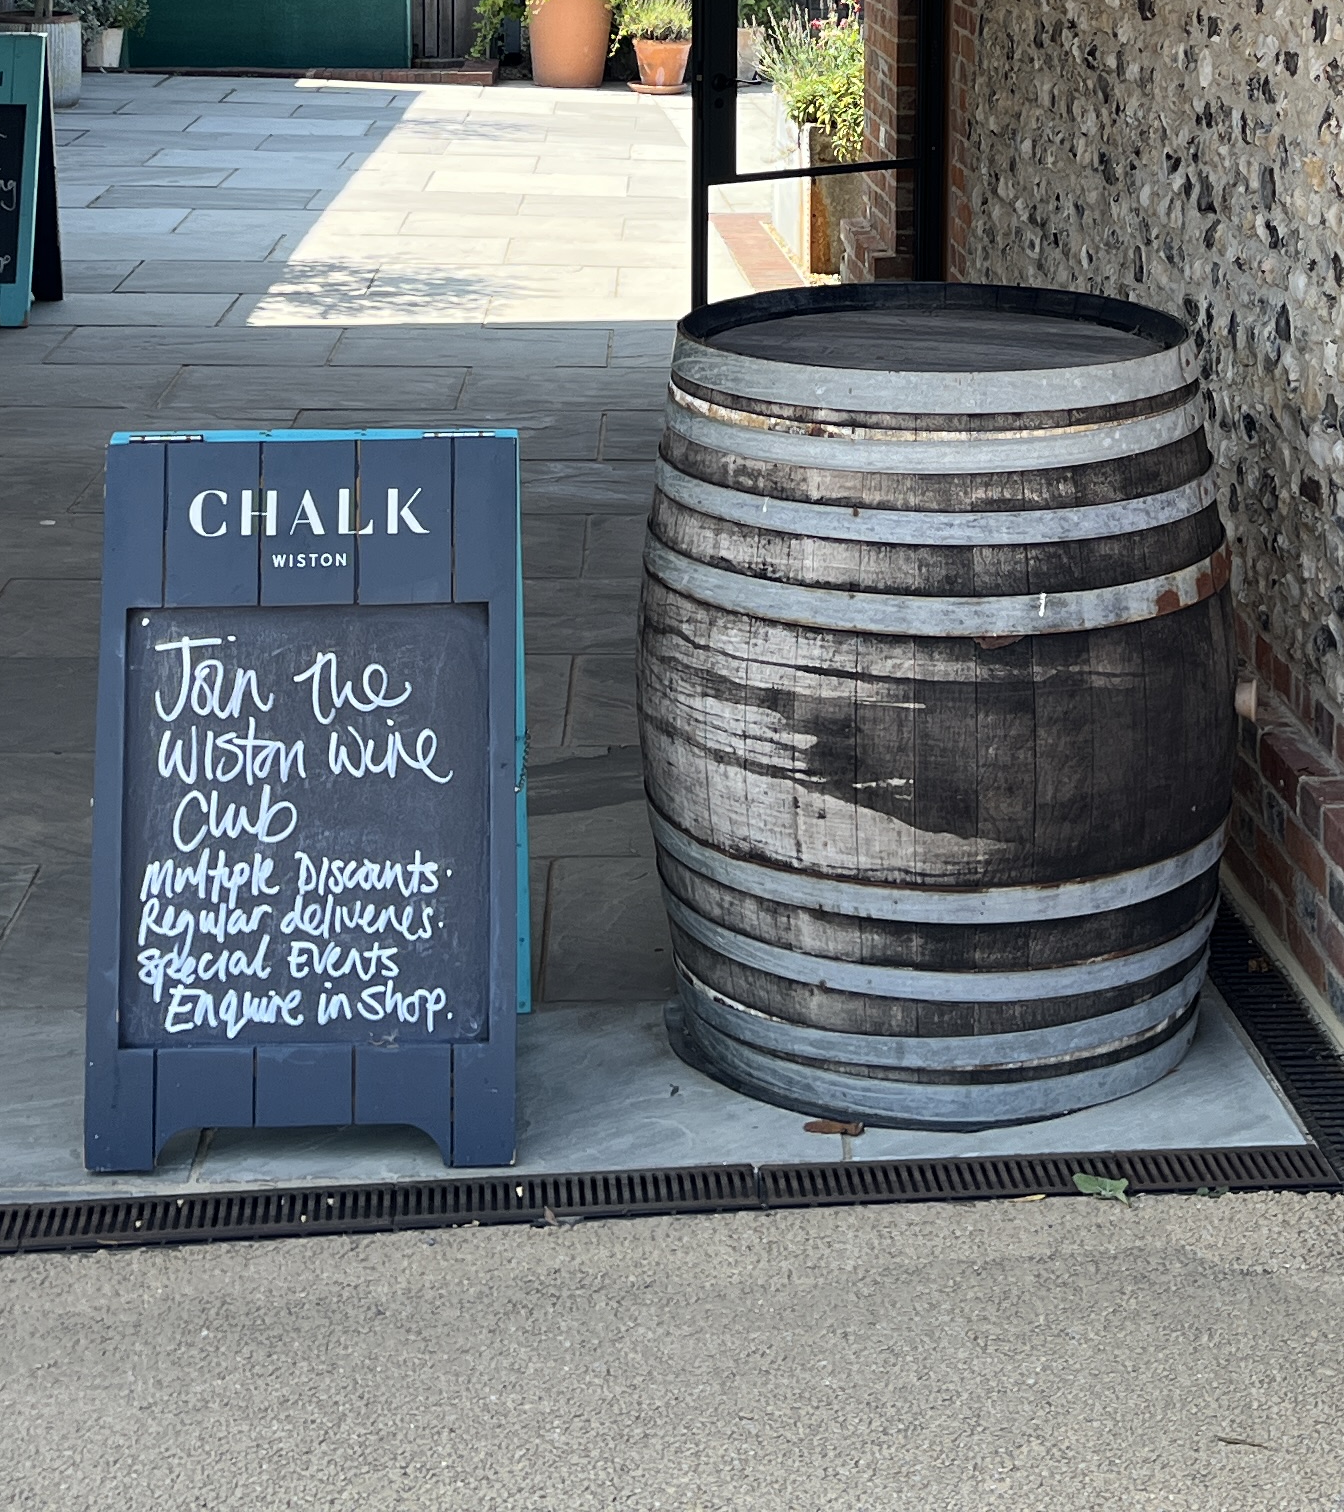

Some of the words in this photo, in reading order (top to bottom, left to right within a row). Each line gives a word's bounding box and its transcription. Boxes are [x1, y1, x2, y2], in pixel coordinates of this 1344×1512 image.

[188, 487, 430, 538] CHALK
[272, 553, 348, 568] WISTON
[155, 636, 274, 722] Join
[172, 783, 299, 851] Club
[139, 847, 281, 910] Multiple
[138, 897, 273, 956] Regular
[287, 940, 400, 980] Events
[164, 985, 305, 1040] Enquire
[316, 981, 354, 1026] in
